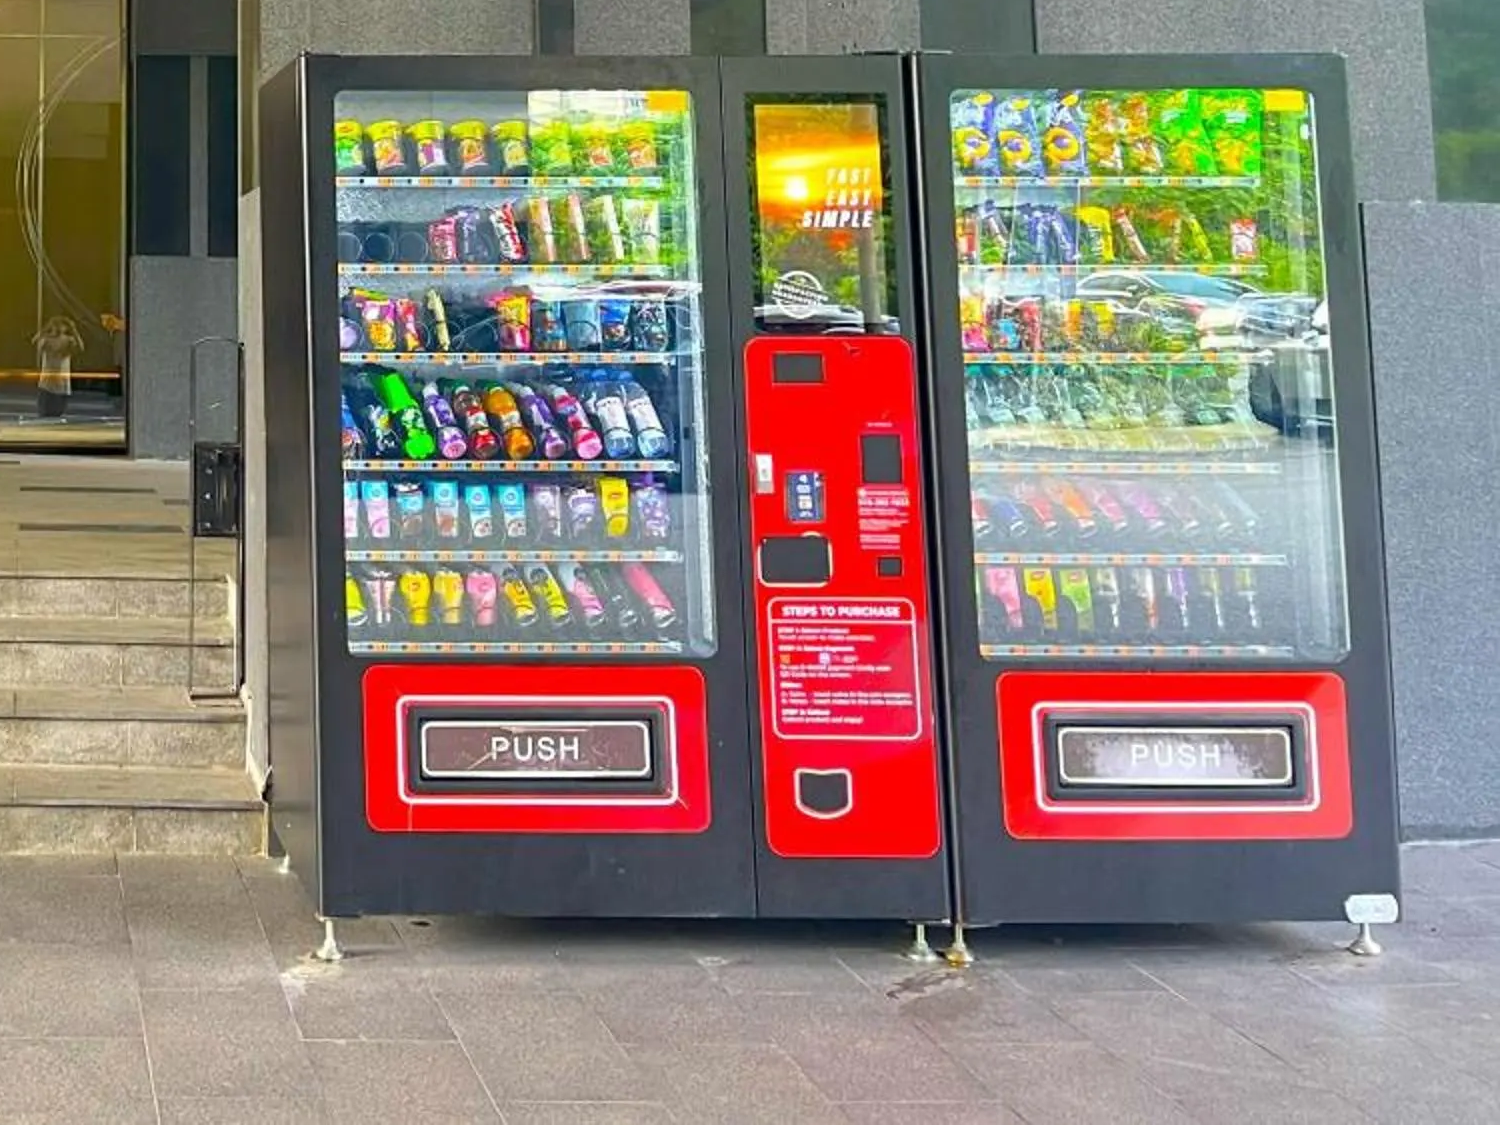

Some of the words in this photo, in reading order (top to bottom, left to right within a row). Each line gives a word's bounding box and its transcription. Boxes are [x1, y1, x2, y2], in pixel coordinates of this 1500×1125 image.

[827, 167, 871, 185] FAST
[825, 189, 871, 207] EASY
[803, 210, 873, 228] SIMPLE
[782, 606, 818, 617] STEPS
[820, 606, 836, 617] TO
[838, 606, 900, 618] PURCHASE
[491, 736, 579, 761] PUSH
[1131, 743, 1221, 768] PUSH
